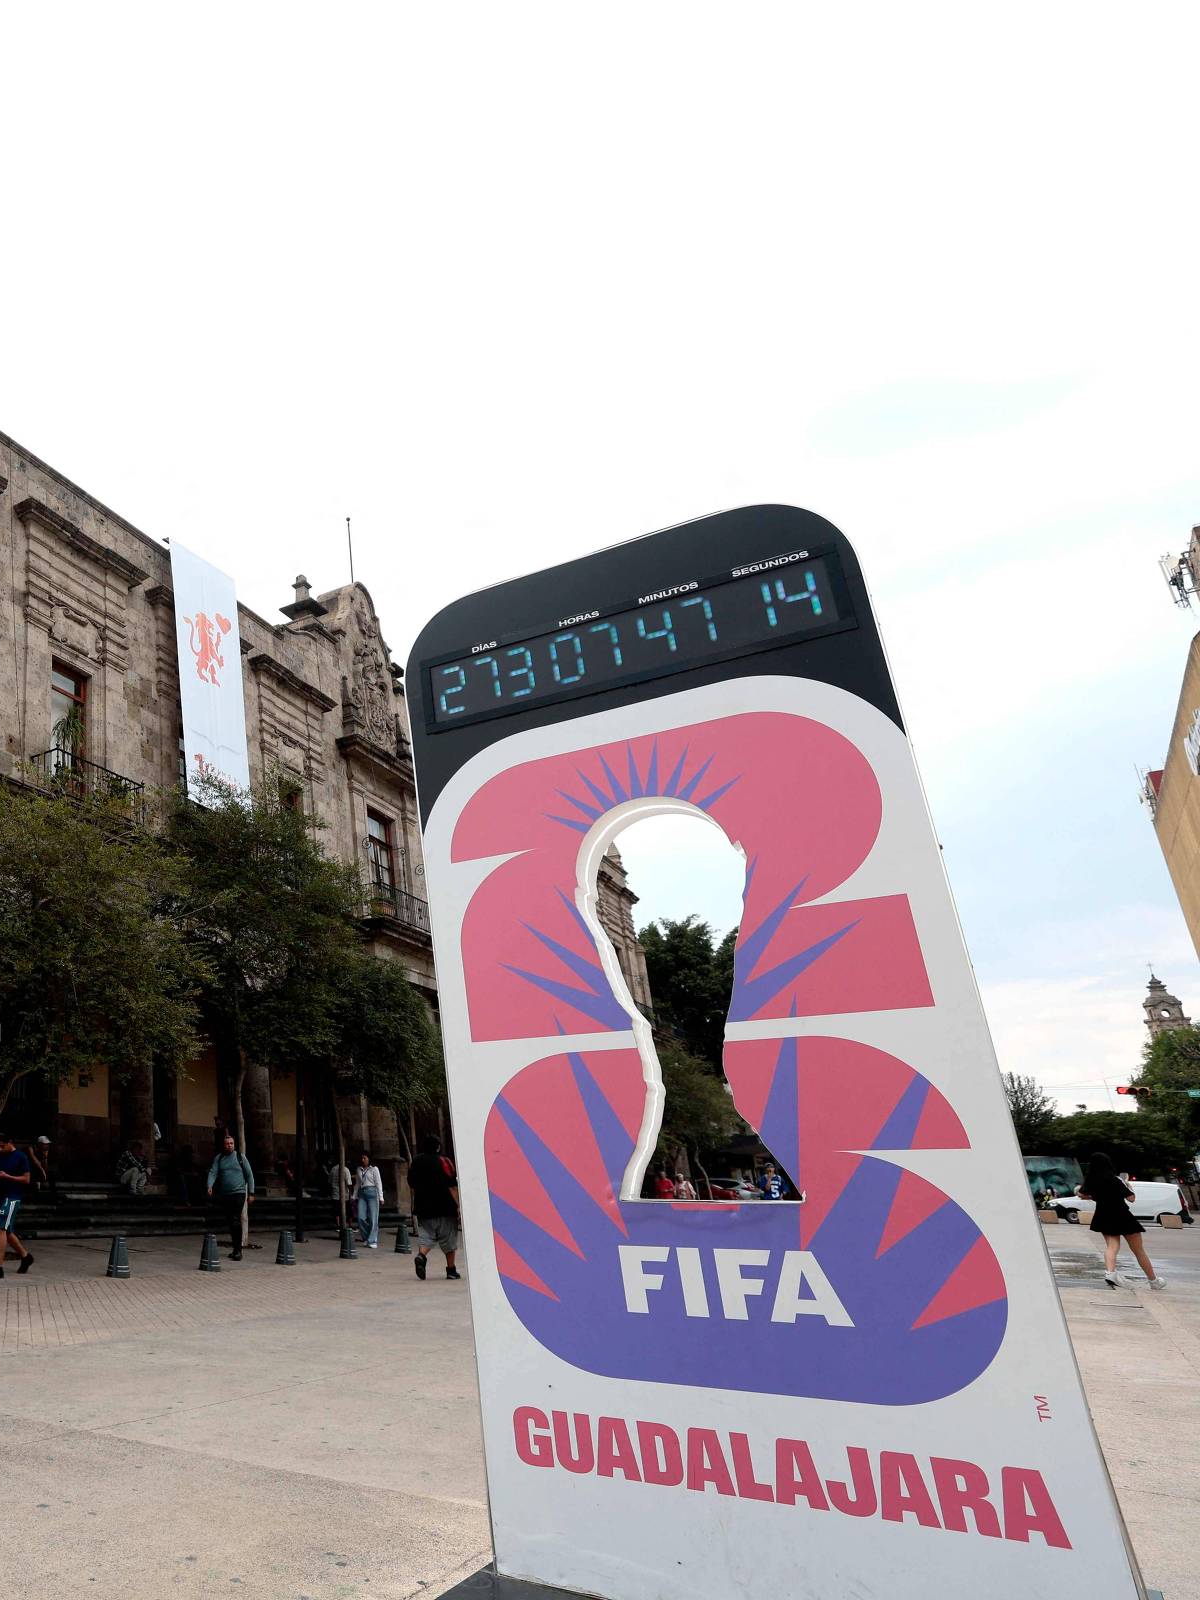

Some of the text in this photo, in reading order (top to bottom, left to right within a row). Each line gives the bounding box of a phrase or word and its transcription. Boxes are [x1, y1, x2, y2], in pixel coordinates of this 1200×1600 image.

[441, 571, 822, 714] 273 07 47 14
[471, 551, 809, 654] DÍAS HORAS MINUTOS SEGUNDOS
[618, 1245, 855, 1328] FIFA
[1033, 1395, 1052, 1422] TM
[513, 1406, 1073, 1550] GUADALAJARA
